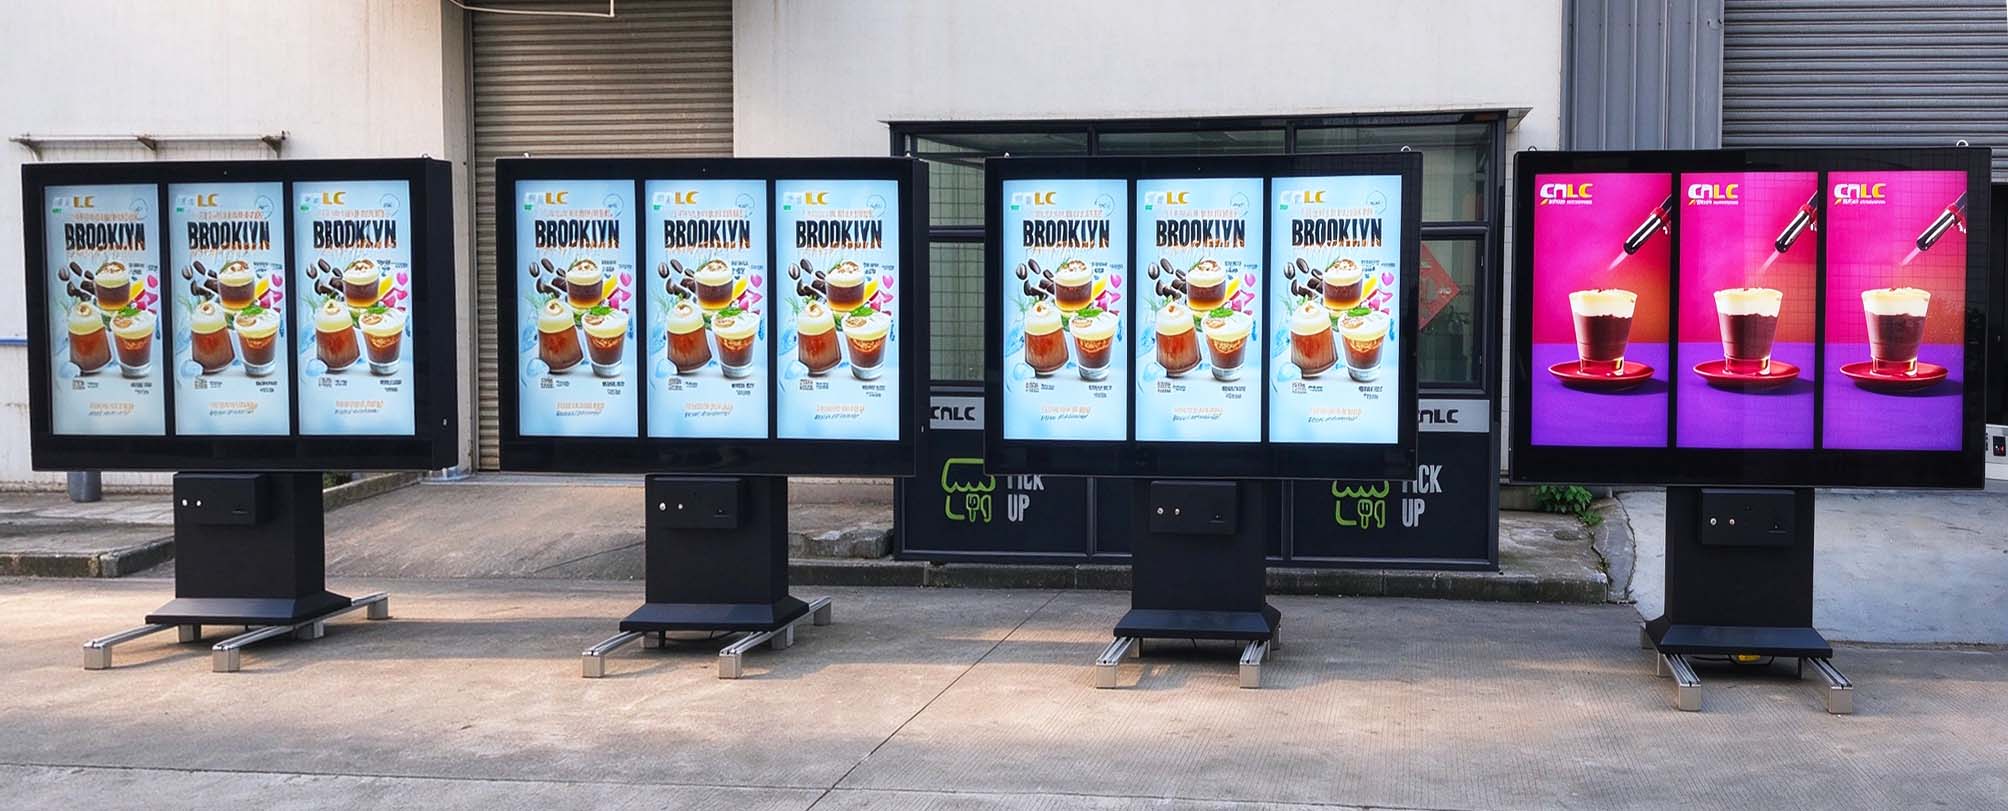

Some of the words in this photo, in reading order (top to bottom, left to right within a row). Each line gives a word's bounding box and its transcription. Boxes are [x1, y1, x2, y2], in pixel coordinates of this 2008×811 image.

[1418, 409, 1459, 424] NLC
[1007, 493, 1031, 522] UP
[1402, 498, 1426, 527] UP
